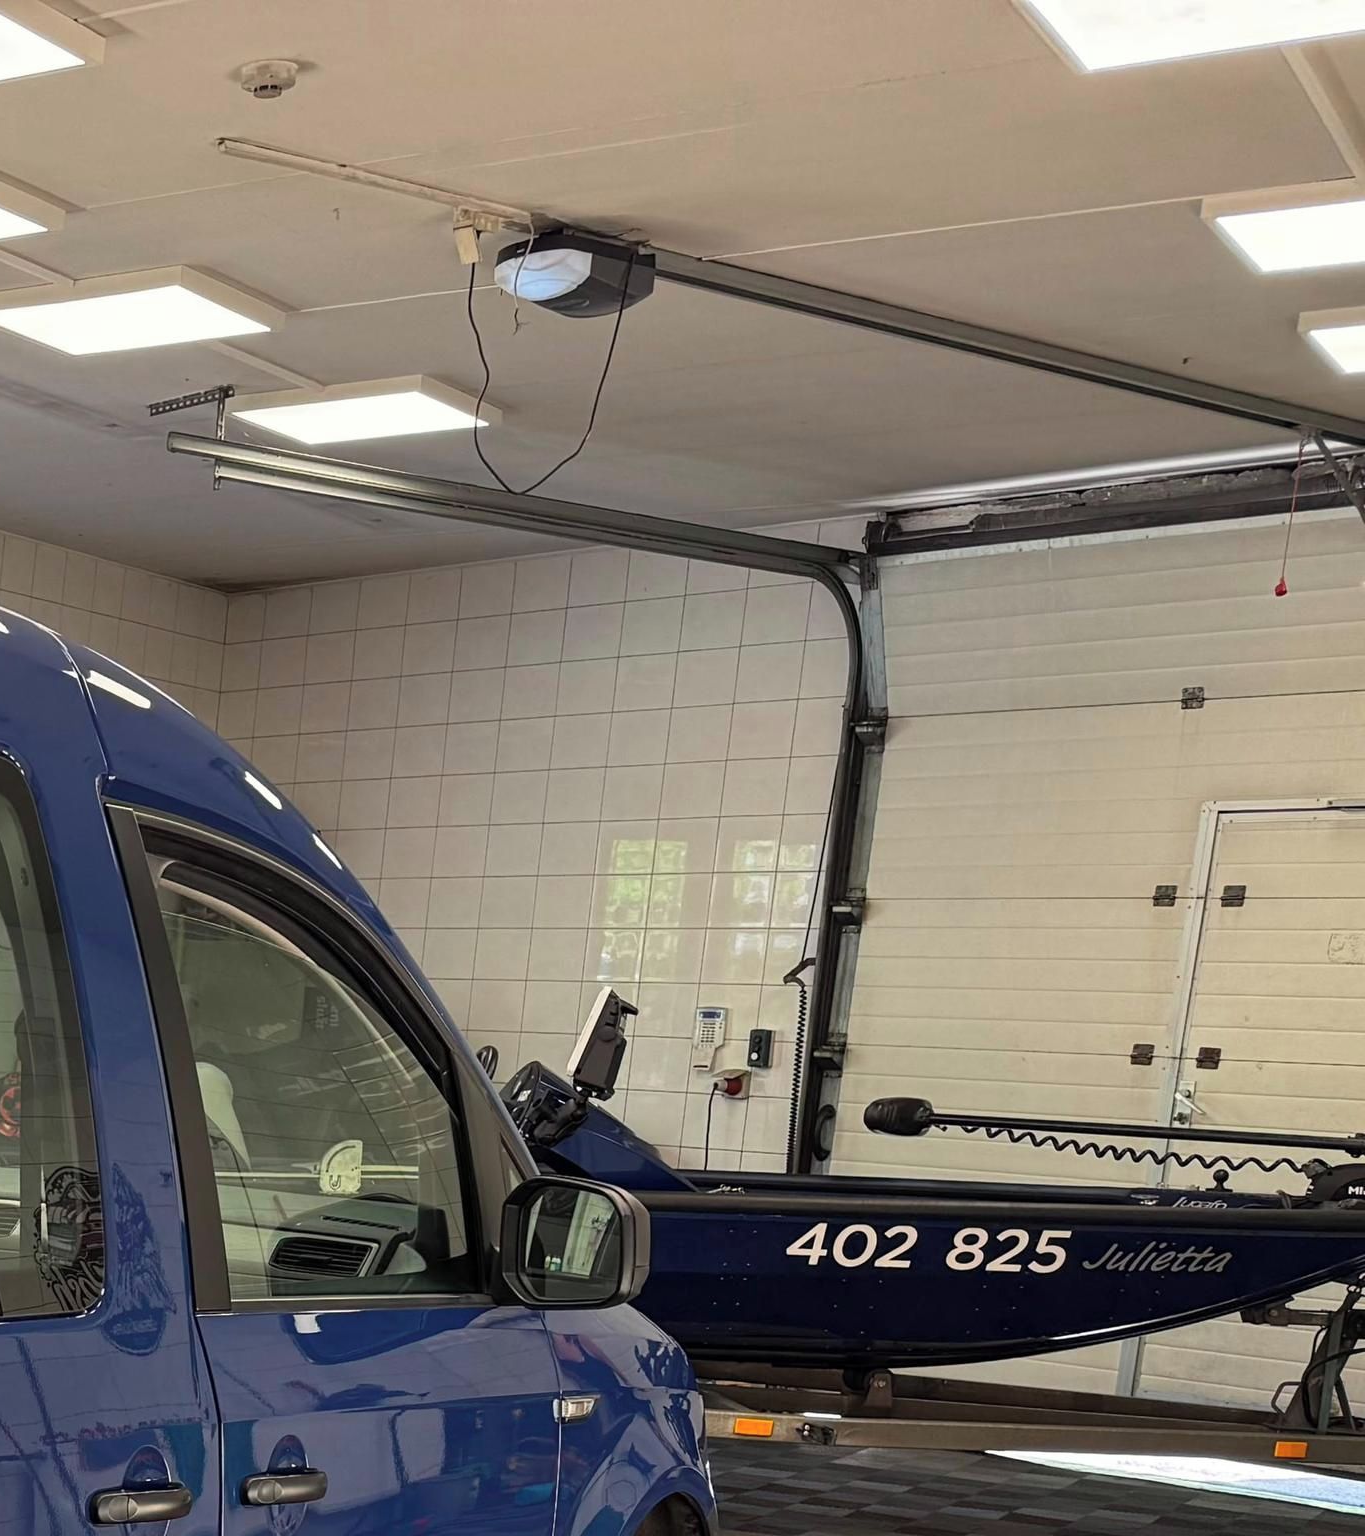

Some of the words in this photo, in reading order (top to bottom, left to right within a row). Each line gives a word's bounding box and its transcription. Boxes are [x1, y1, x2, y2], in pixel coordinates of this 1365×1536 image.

[786, 1223, 918, 1269] 402
[945, 1227, 1073, 1274] 825
[1082, 1241, 1233, 1274] Julietta
